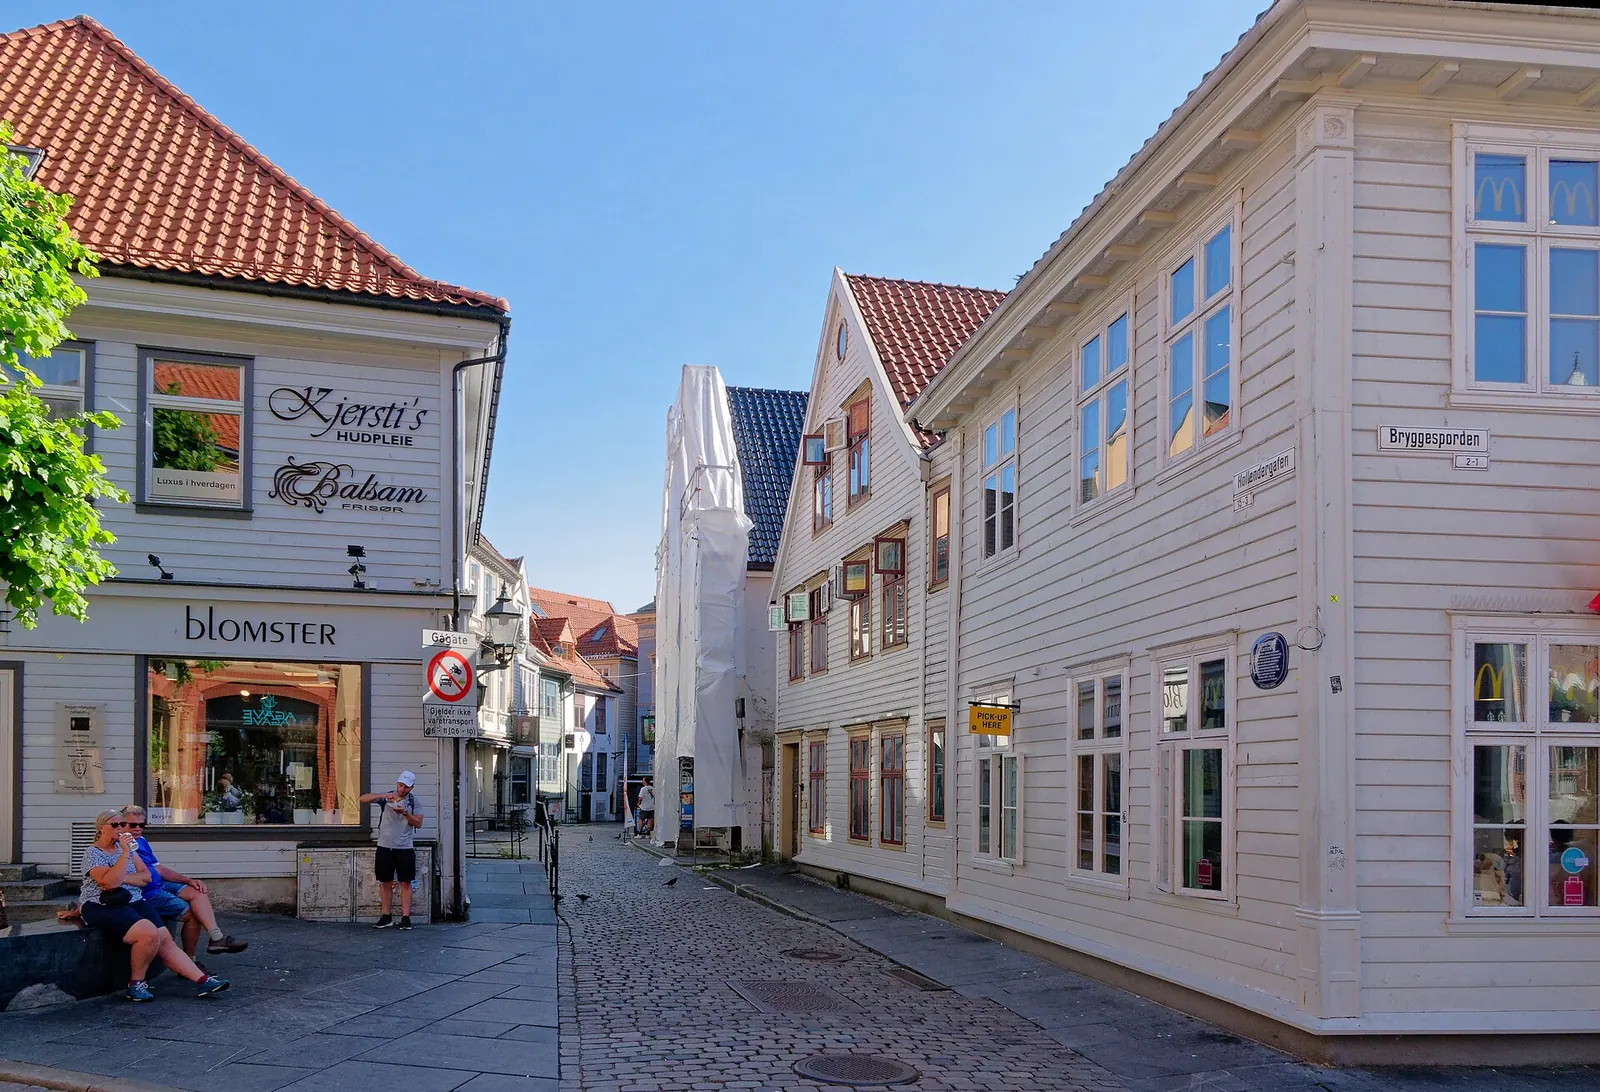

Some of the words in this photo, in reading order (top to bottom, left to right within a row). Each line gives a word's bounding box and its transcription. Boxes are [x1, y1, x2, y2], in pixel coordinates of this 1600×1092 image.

[268, 386, 428, 437] Kjersti's
[336, 431, 413, 447] HUDPLEIE
[1389, 428, 1480, 448] Bryggesporden
[1465, 457, 1479, 466] 2-1
[1237, 455, 1289, 489] Hollendergaten
[157, 477, 184, 486] Luxus
[191, 479, 236, 490] hverdagen
[285, 460, 428, 505] Balsam
[341, 503, 405, 513] FRISØR
[430, 707, 456, 717] Gjelder
[457, 708, 472, 717] ikke
[977, 712, 1008, 722] PICK-UP
[427, 718, 475, 727] varetransport
[982, 721, 1002, 730] HERE
